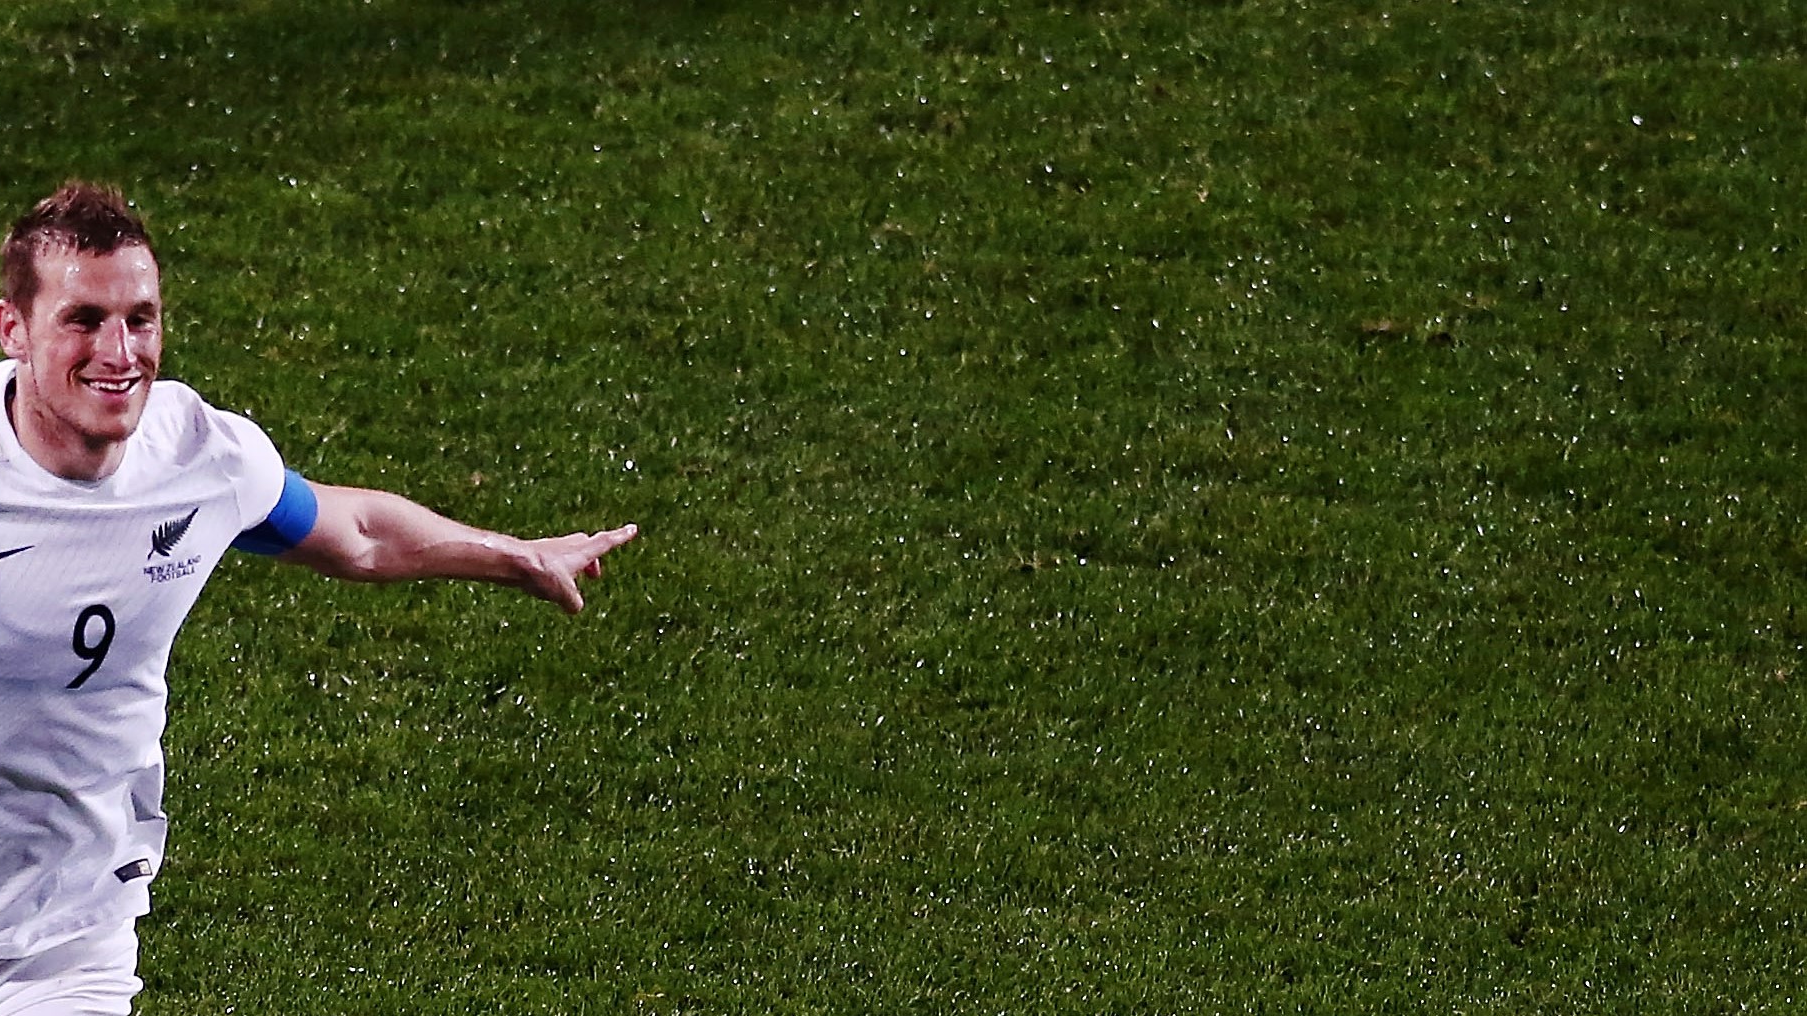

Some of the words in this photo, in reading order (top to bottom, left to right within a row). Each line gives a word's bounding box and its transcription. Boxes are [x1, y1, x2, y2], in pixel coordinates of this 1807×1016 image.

[143, 566, 165, 575] NEW
[166, 555, 201, 572] ZEALAND
[151, 566, 195, 583] FOOTBALL
[66, 604, 116, 689] 9
